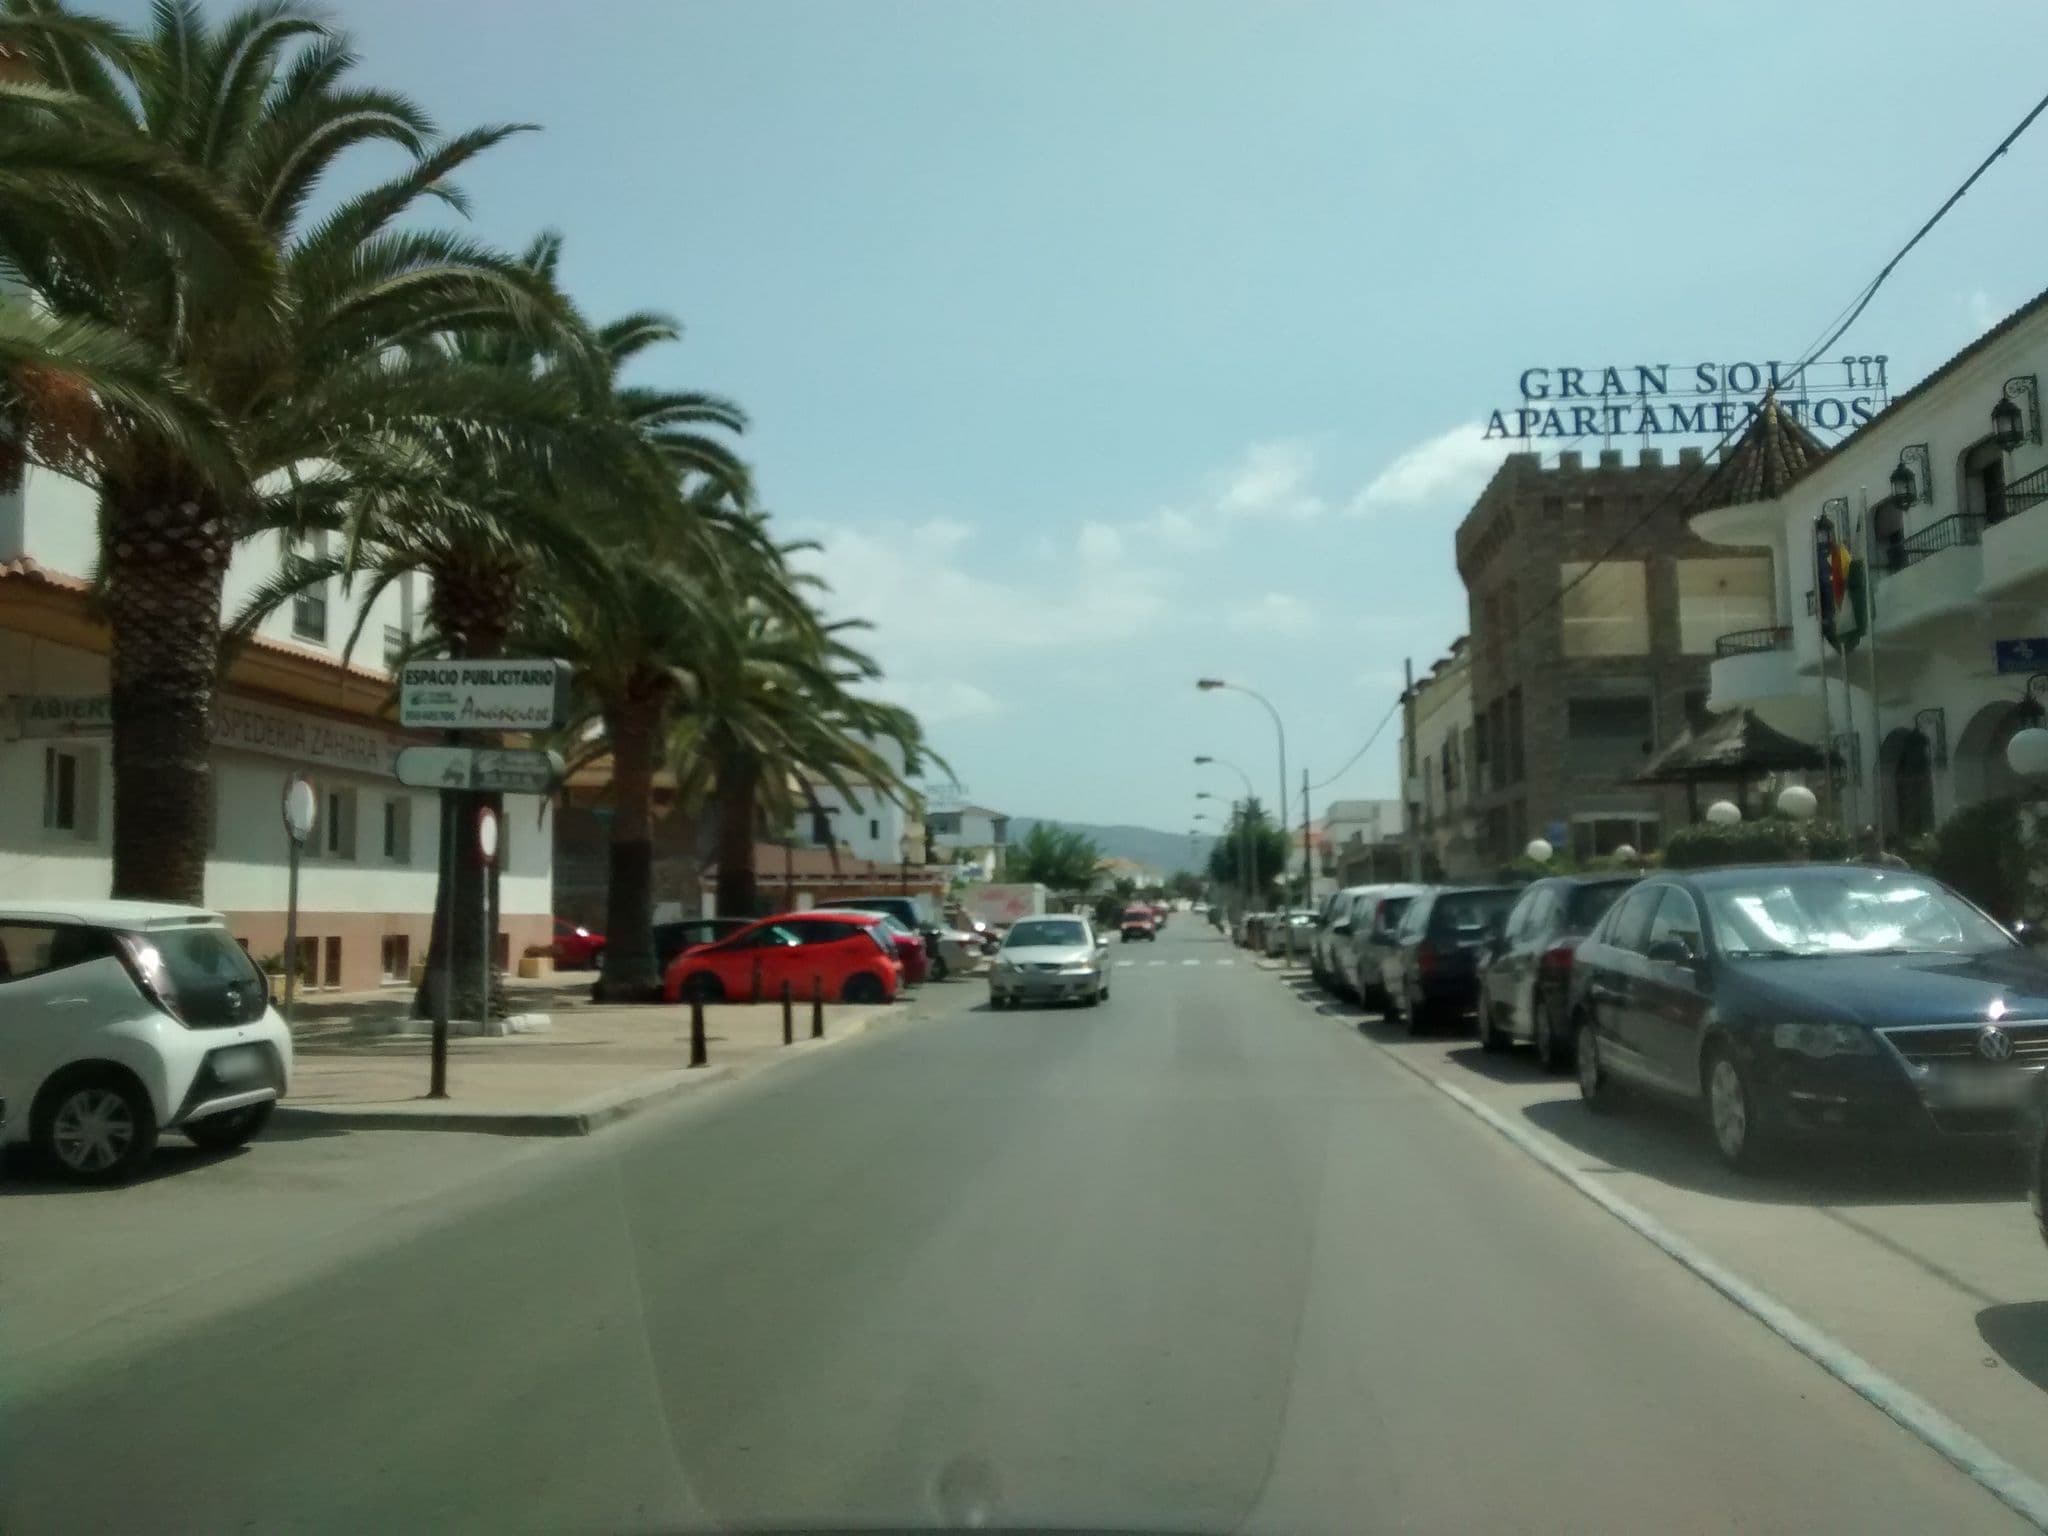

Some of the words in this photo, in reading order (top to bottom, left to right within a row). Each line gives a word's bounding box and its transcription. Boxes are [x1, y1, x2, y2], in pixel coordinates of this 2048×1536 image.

[1519, 363, 1670, 399] GRAN
[1695, 359, 1794, 395] SOL
[1483, 396, 1873, 440] APARTAMENTOS
[405, 669, 459, 686] ESPACIO
[462, 669, 553, 687] PUBLICITARIO
[31, 696, 112, 720] ABIER
